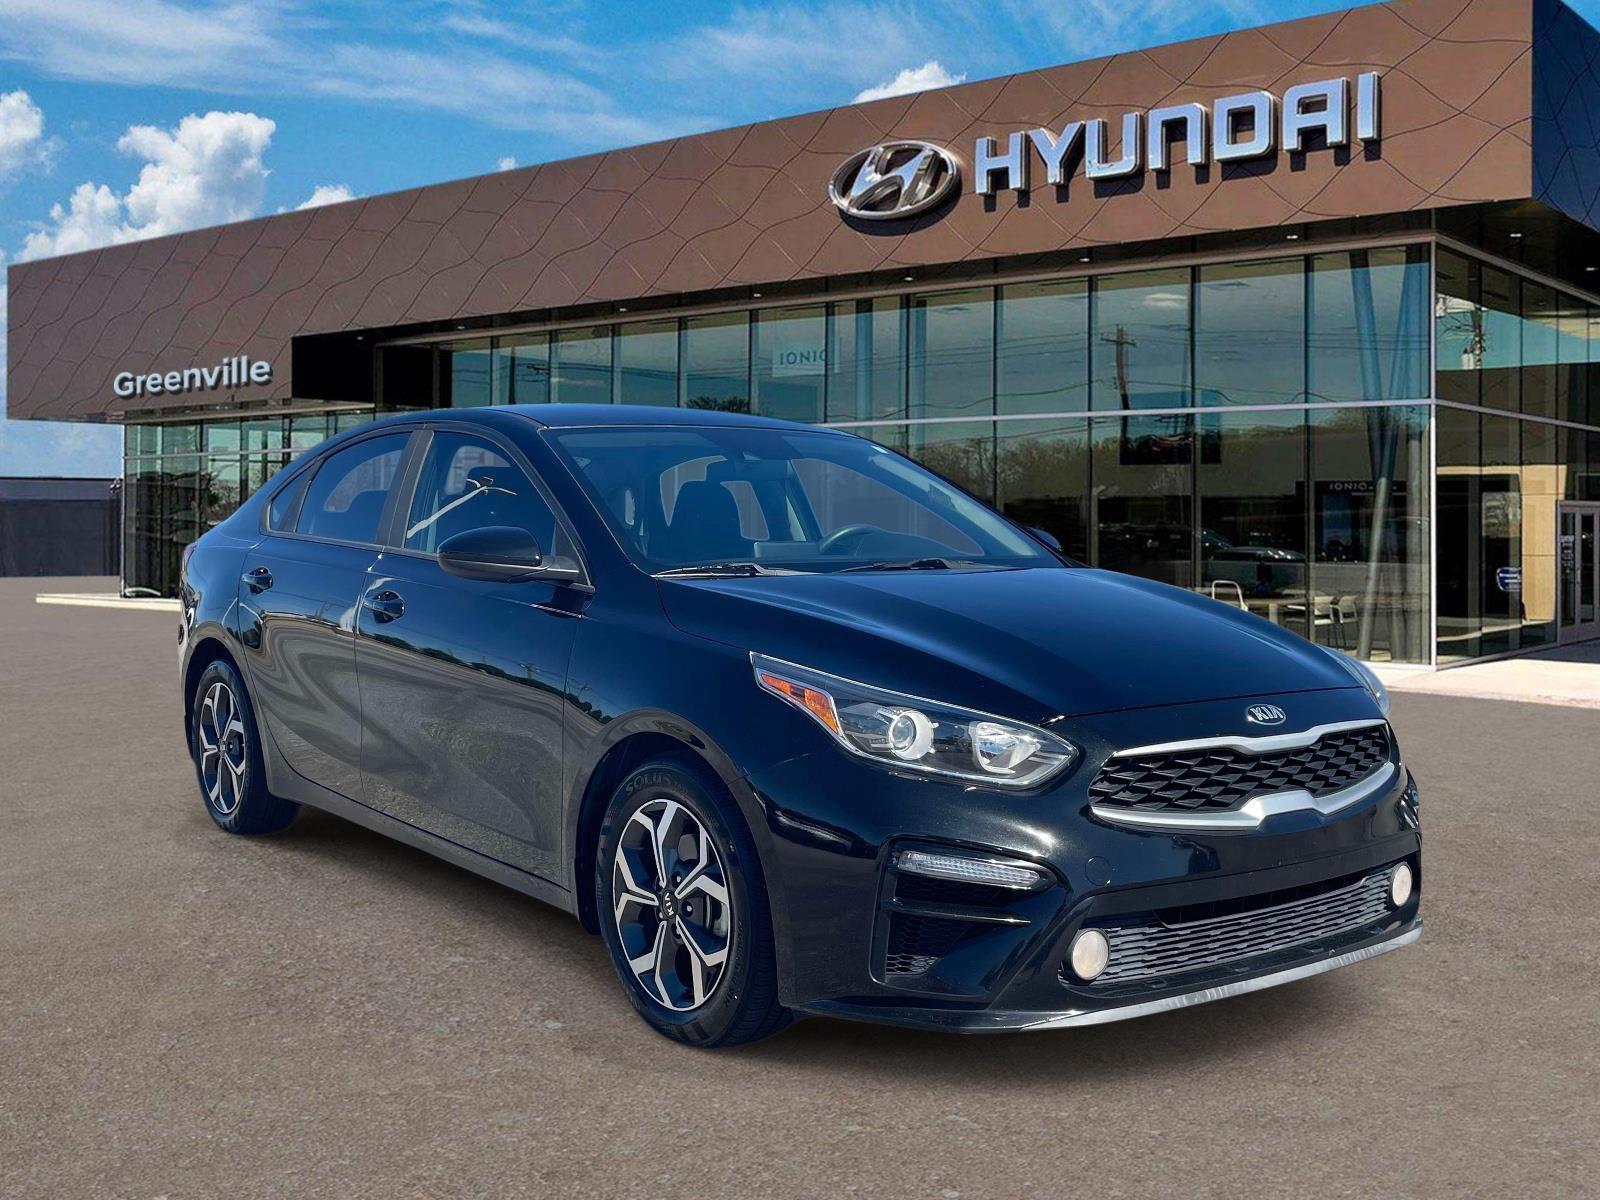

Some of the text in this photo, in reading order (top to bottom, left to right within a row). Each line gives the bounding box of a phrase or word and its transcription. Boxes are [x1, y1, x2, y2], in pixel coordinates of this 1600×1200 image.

[974, 72, 1381, 196] HYUNDAI
[113, 355, 271, 396] Greenville
[1249, 706, 1284, 721] KIA
[664, 892, 674, 916] KIA
